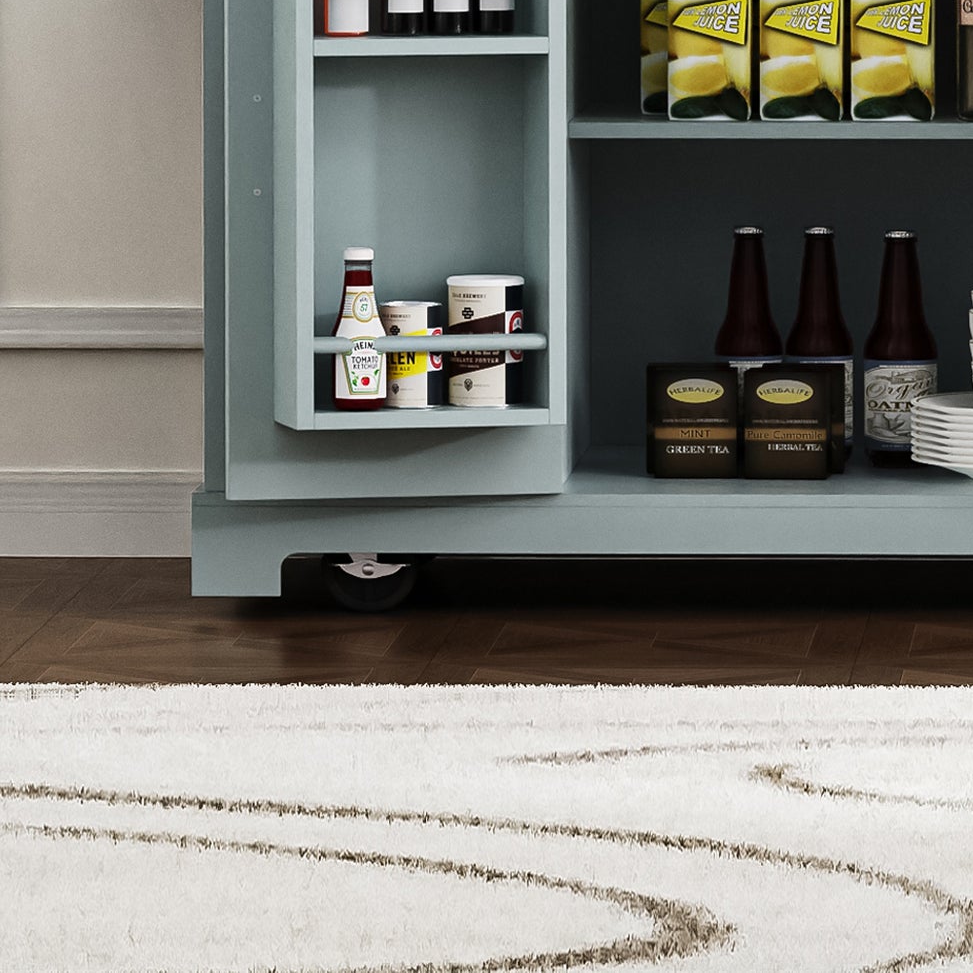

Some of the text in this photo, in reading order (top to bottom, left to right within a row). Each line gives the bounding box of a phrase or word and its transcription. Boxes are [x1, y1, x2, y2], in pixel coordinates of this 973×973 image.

[694, 15, 740, 34] JUICE
[786, 15, 832, 34] JUICE
[877, 15, 923, 34] JUICE
[354, 341, 375, 351] HEIN
[680, 430, 711, 438] MINT
[747, 430, 823, 439] Pure Camomile
[666, 445, 730, 454] GREEN TEA
[768, 443, 823, 451] HERBAL TEA
